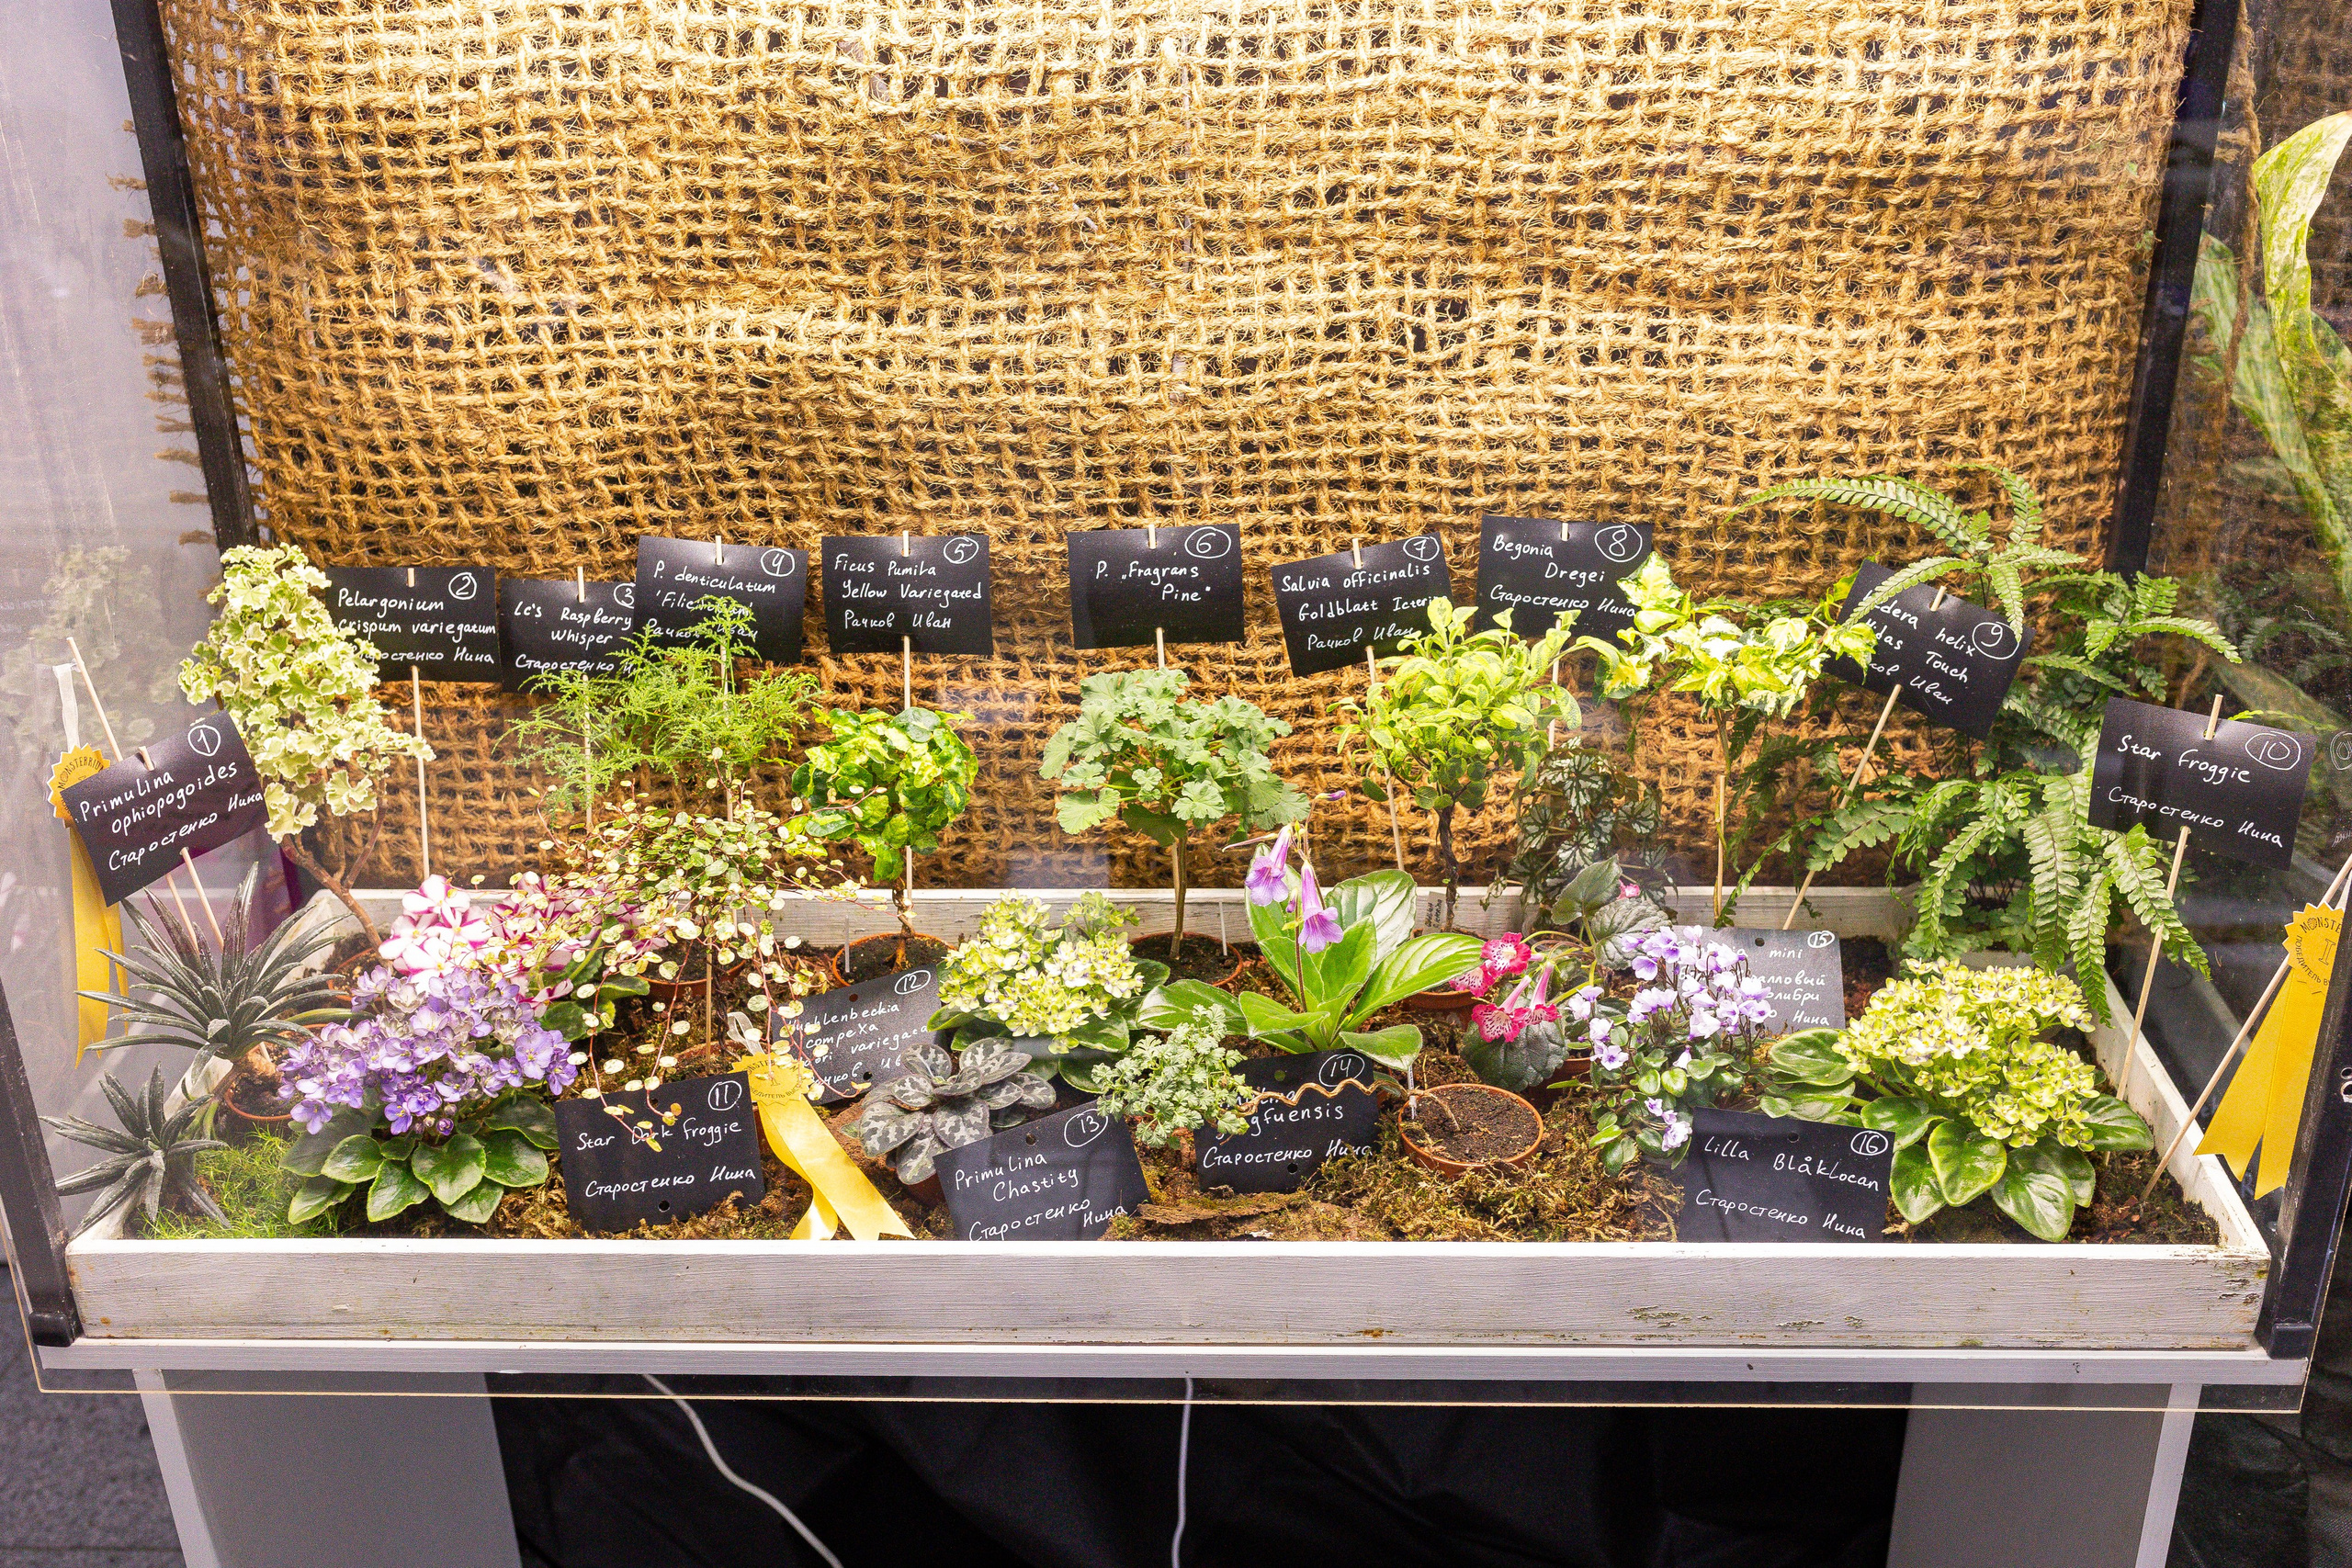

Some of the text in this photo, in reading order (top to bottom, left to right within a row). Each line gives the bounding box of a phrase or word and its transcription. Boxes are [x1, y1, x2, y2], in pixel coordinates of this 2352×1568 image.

[954, 543, 973, 562] 5
[1196, 533, 1216, 553] 6
[1493, 535, 1553, 559] Begonia
[1609, 529, 1627, 556] 8
[834, 554, 875, 572] Ficus
[1096, 560, 1108, 579] P.
[653, 559, 775, 593] P. denticulatum
[1282, 563, 1430, 592] Salvia officinalis
[1544, 562, 1604, 588] Dregei
[338, 588, 444, 618] Pelargonium
[842, 580, 981, 608] Yellow Variegated
[560, 607, 632, 630] Raspberry
[1299, 598, 1377, 621] Goldblatt
[1598, 598, 1635, 616] Нина
[845, 609, 951, 629] Рачков Иван
[413, 621, 496, 643] variegatum
[551, 629, 612, 650] Whisper
[1308, 624, 1413, 650] Рачков Иван
[1936, 628, 1975, 657] helix
[1982, 624, 2003, 647] 9
[454, 647, 494, 663] Нина
[515, 654, 614, 673] Старостенко
[1927, 651, 1967, 682] Touch
[1910, 676, 1952, 705] Иван
[2118, 735, 2161, 760] Star
[2259, 741, 2290, 760] 10
[80, 772, 174, 821] Primulina
[2109, 787, 2282, 847] Старостенко Нина
[108, 793, 263, 871] Старостенко Нина
[1770, 948, 1803, 959] mini
[1765, 988, 1820, 1007] олибри
[1792, 1010, 1829, 1026] Нина
[1330, 1058, 1351, 1077] 14
[577, 1133, 615, 1150] Star
[1704, 1136, 1749, 1160] Lilla
[1859, 1134, 1880, 1154] 16
[1204, 1146, 1312, 1168] Старостенко
[956, 1153, 1047, 1190] Primulina
[586, 1166, 755, 1201] Старостенко Нина
[993, 1168, 1078, 1201] Chastity
[969, 1199, 1127, 1241] Старостенко Нина
[1695, 1189, 1865, 1239] Старостенко Нина
